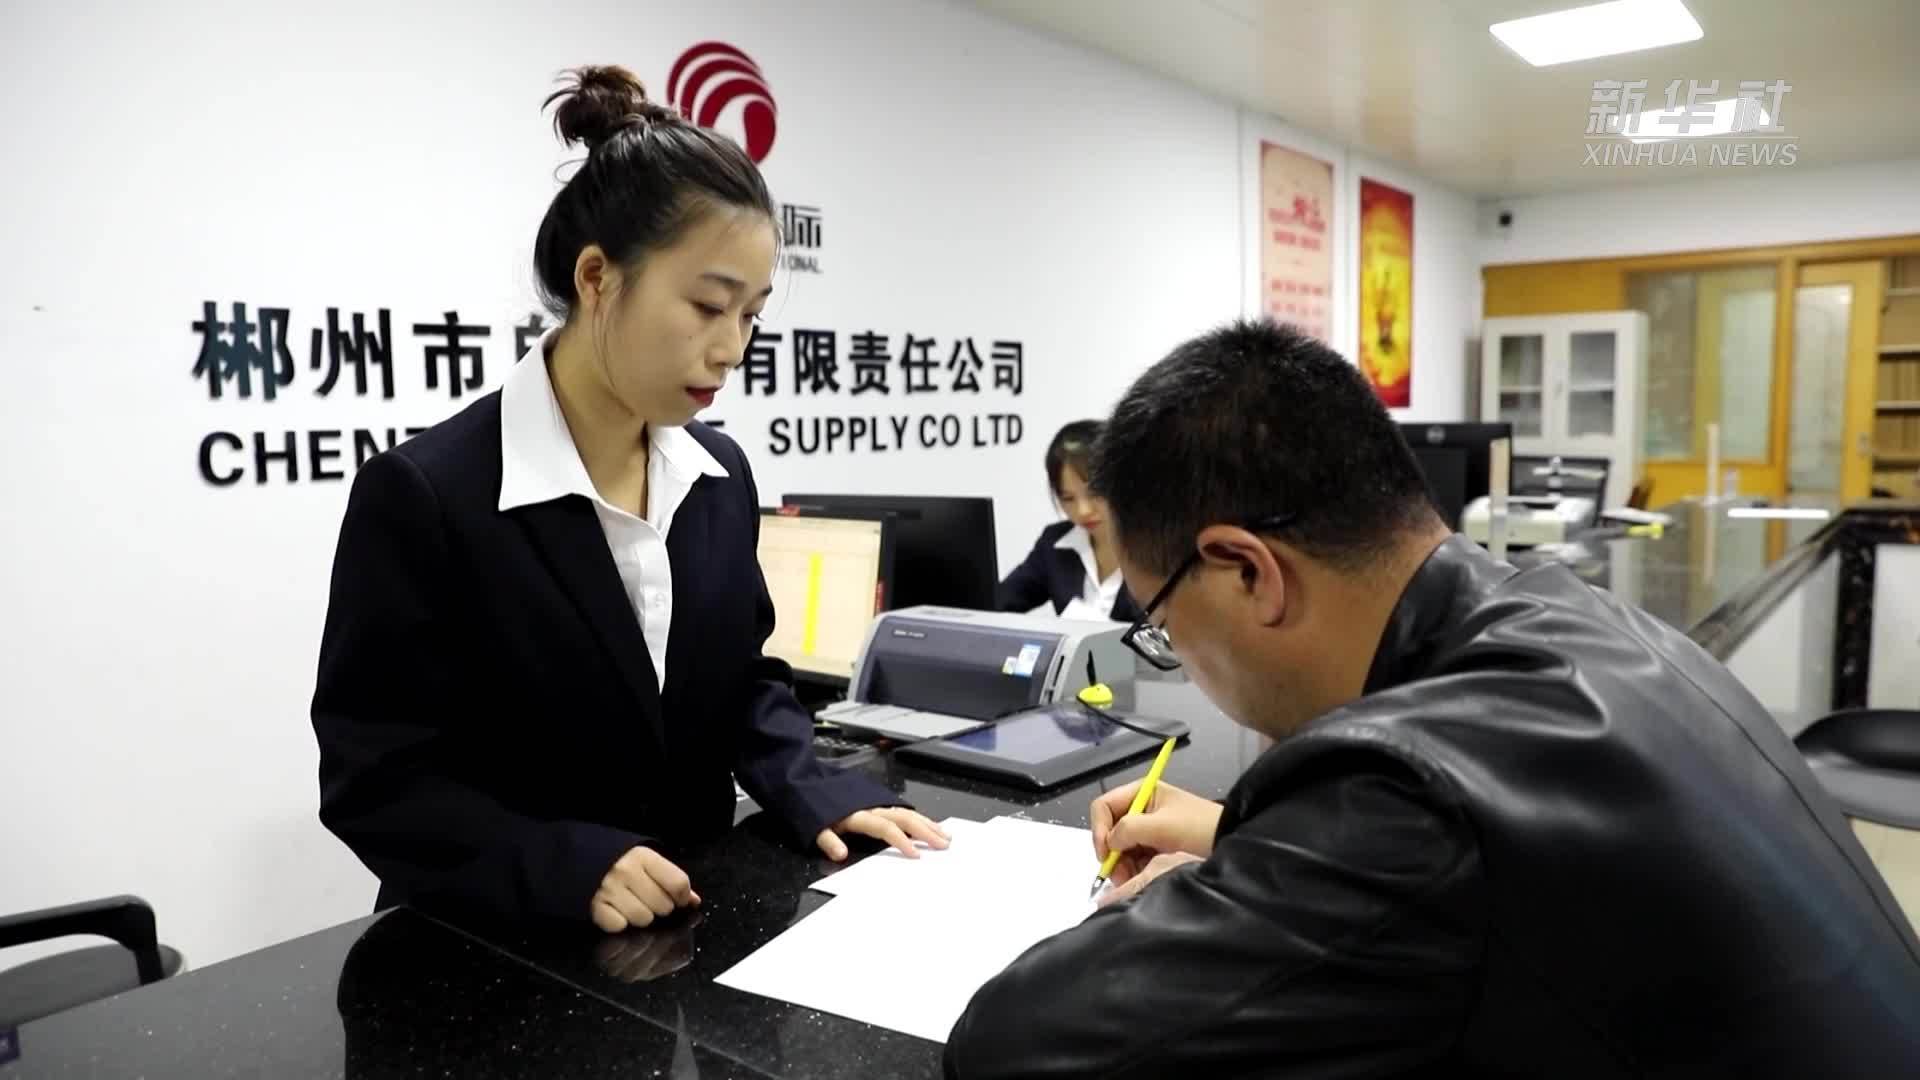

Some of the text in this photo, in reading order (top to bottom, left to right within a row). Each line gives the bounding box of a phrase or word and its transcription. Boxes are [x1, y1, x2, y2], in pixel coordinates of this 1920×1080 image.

[198, 413, 1024, 488] CHEN SUPPLY CO LTD
